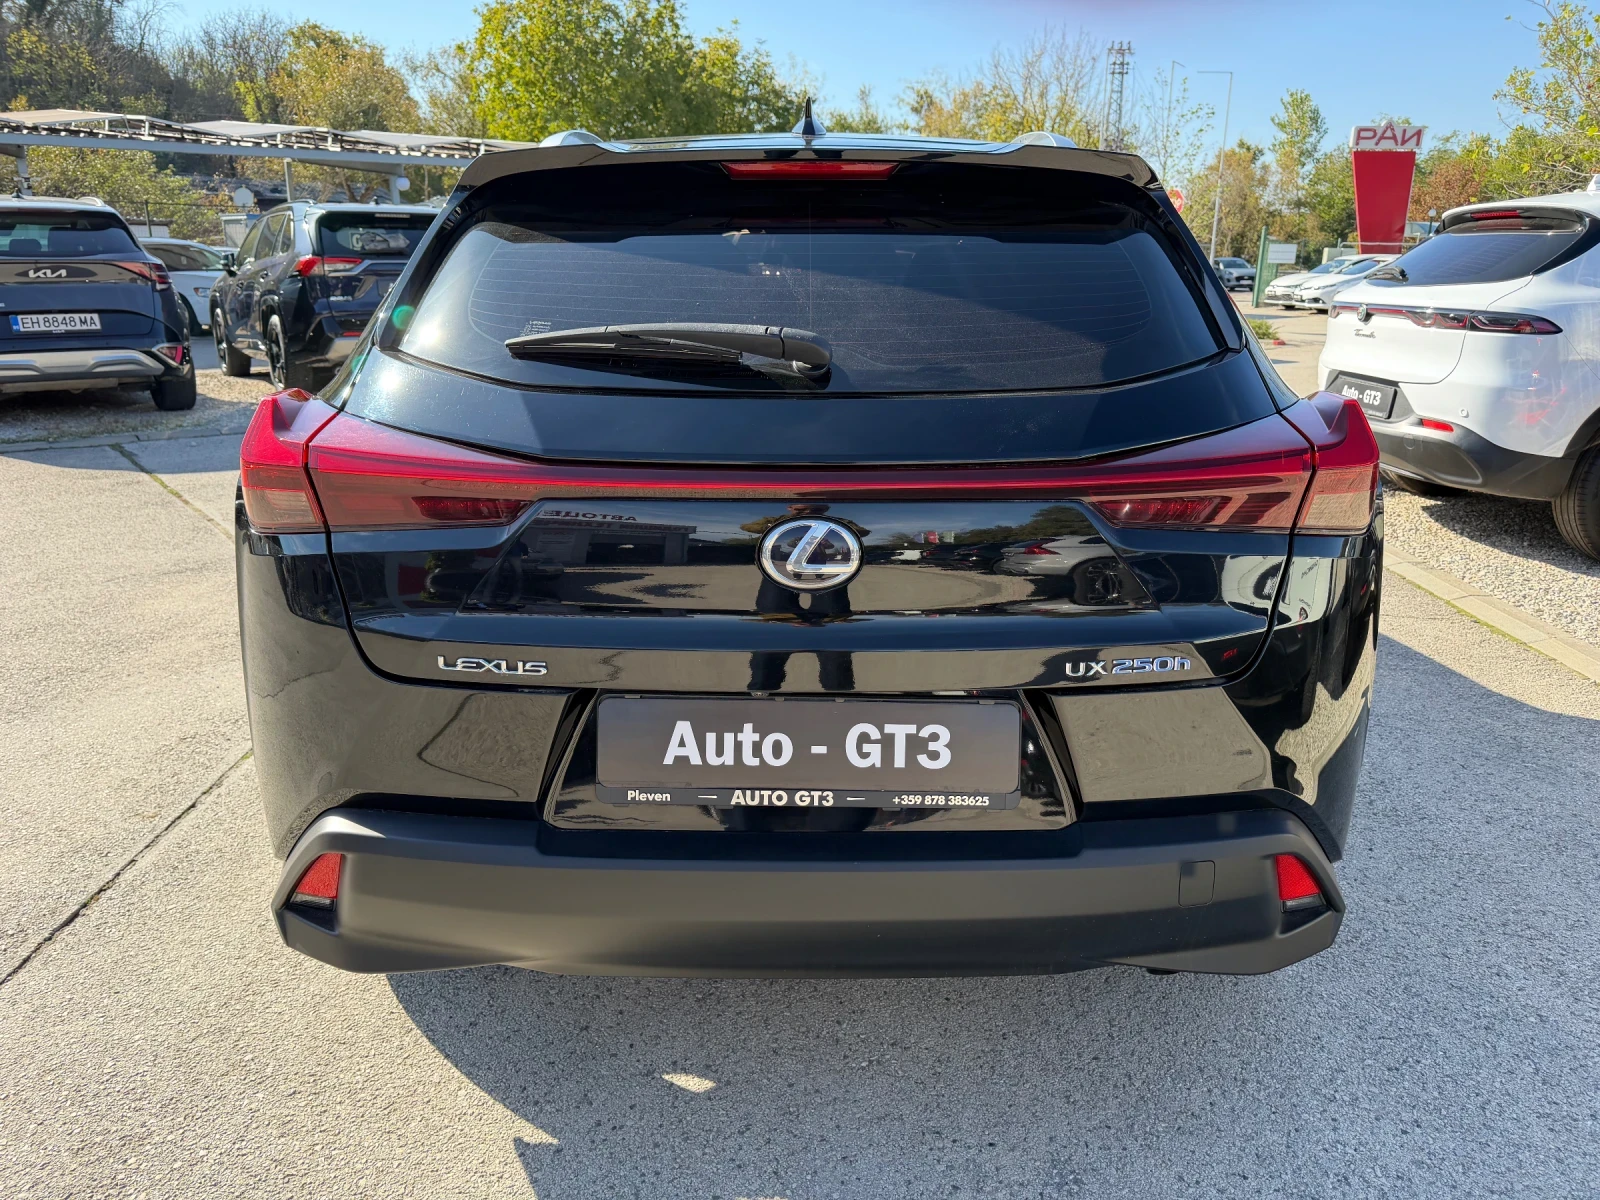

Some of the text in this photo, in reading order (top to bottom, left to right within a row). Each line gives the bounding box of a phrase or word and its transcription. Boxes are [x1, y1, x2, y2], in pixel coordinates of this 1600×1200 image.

[28, 269, 67, 278] KIA
[21, 317, 41, 329] EH
[43, 316, 77, 328] 8848
[79, 315, 98, 327] MA
[1363, 389, 1382, 406] GT3
[437, 655, 548, 676] LEXUS
[1065, 656, 1191, 677] UX 250h
[662, 720, 794, 768] Auto
[845, 722, 953, 770] GT3
[627, 789, 990, 808] Pleven AUTO GT3 +359 878 383625
